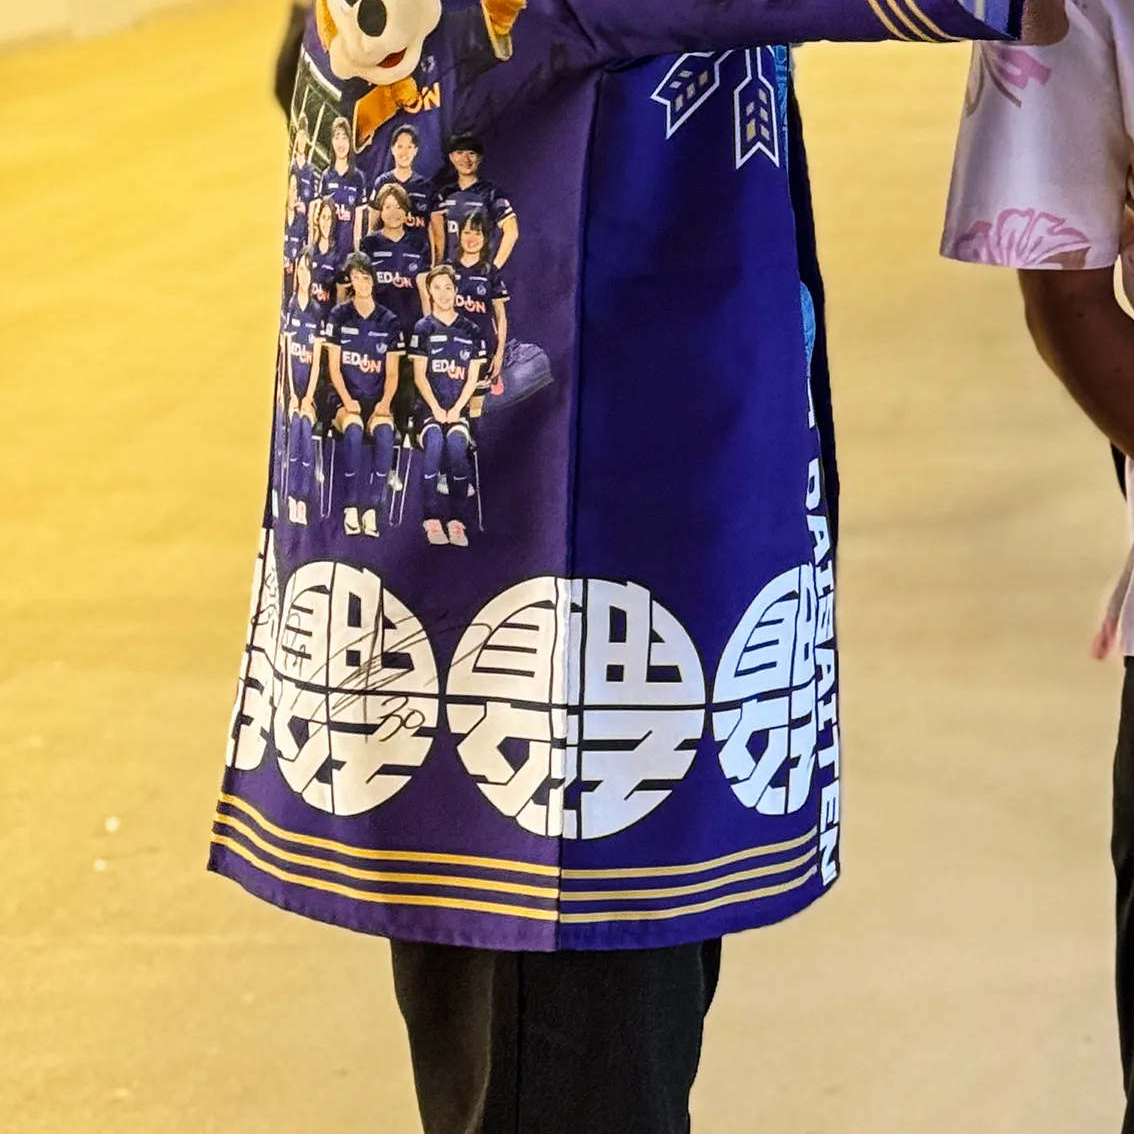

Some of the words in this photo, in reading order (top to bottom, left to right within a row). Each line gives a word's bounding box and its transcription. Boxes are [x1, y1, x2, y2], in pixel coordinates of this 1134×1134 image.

[455, 295, 487, 314] DION
[342, 350, 382, 374] EDION
[805, 457, 840, 886] DAISAITEN
